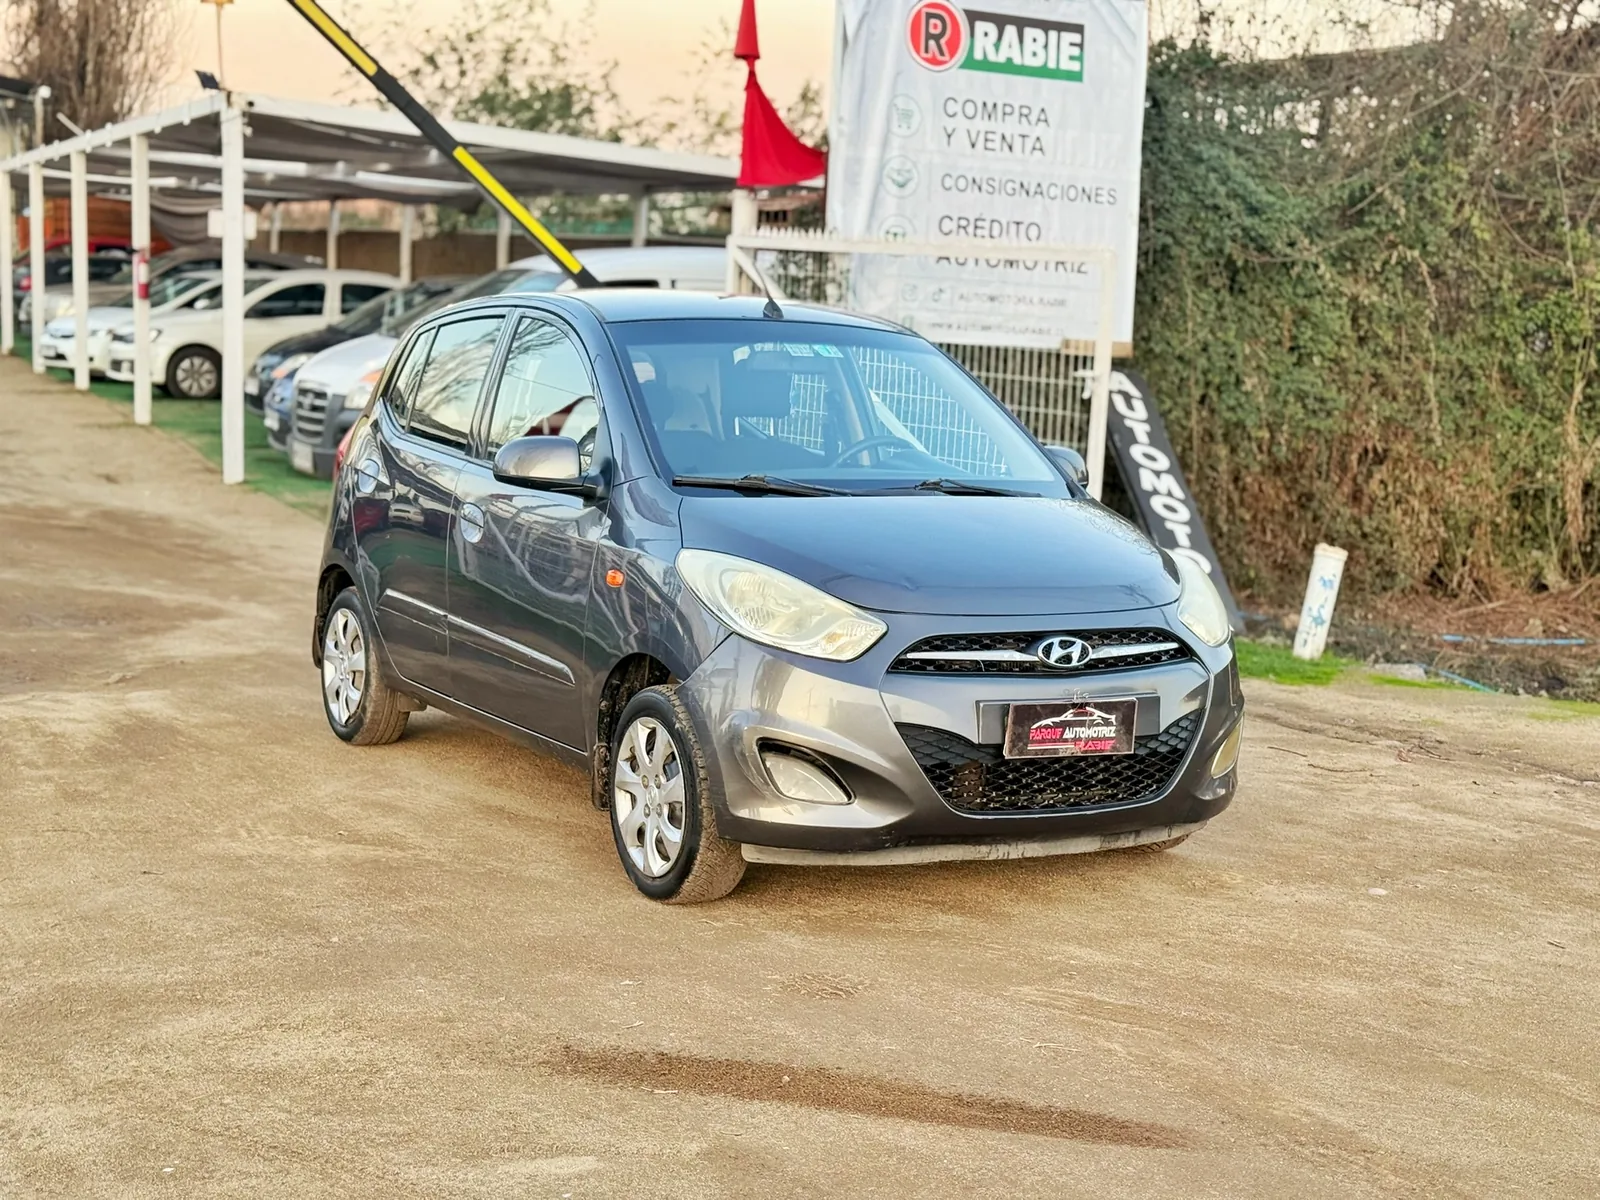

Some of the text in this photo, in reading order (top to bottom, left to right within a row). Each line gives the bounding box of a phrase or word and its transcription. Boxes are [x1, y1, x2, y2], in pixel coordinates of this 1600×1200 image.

[921, 9, 950, 61] R
[973, 20, 1082, 72] RABIE
[943, 96, 1050, 128] COMPRA
[943, 125, 1046, 156] Y VENTA
[941, 173, 1118, 205] CONSIGNACIONES
[938, 212, 1042, 242] CRÉDITO
[1062, 726, 1116, 739] AUTOMOTRIZ
